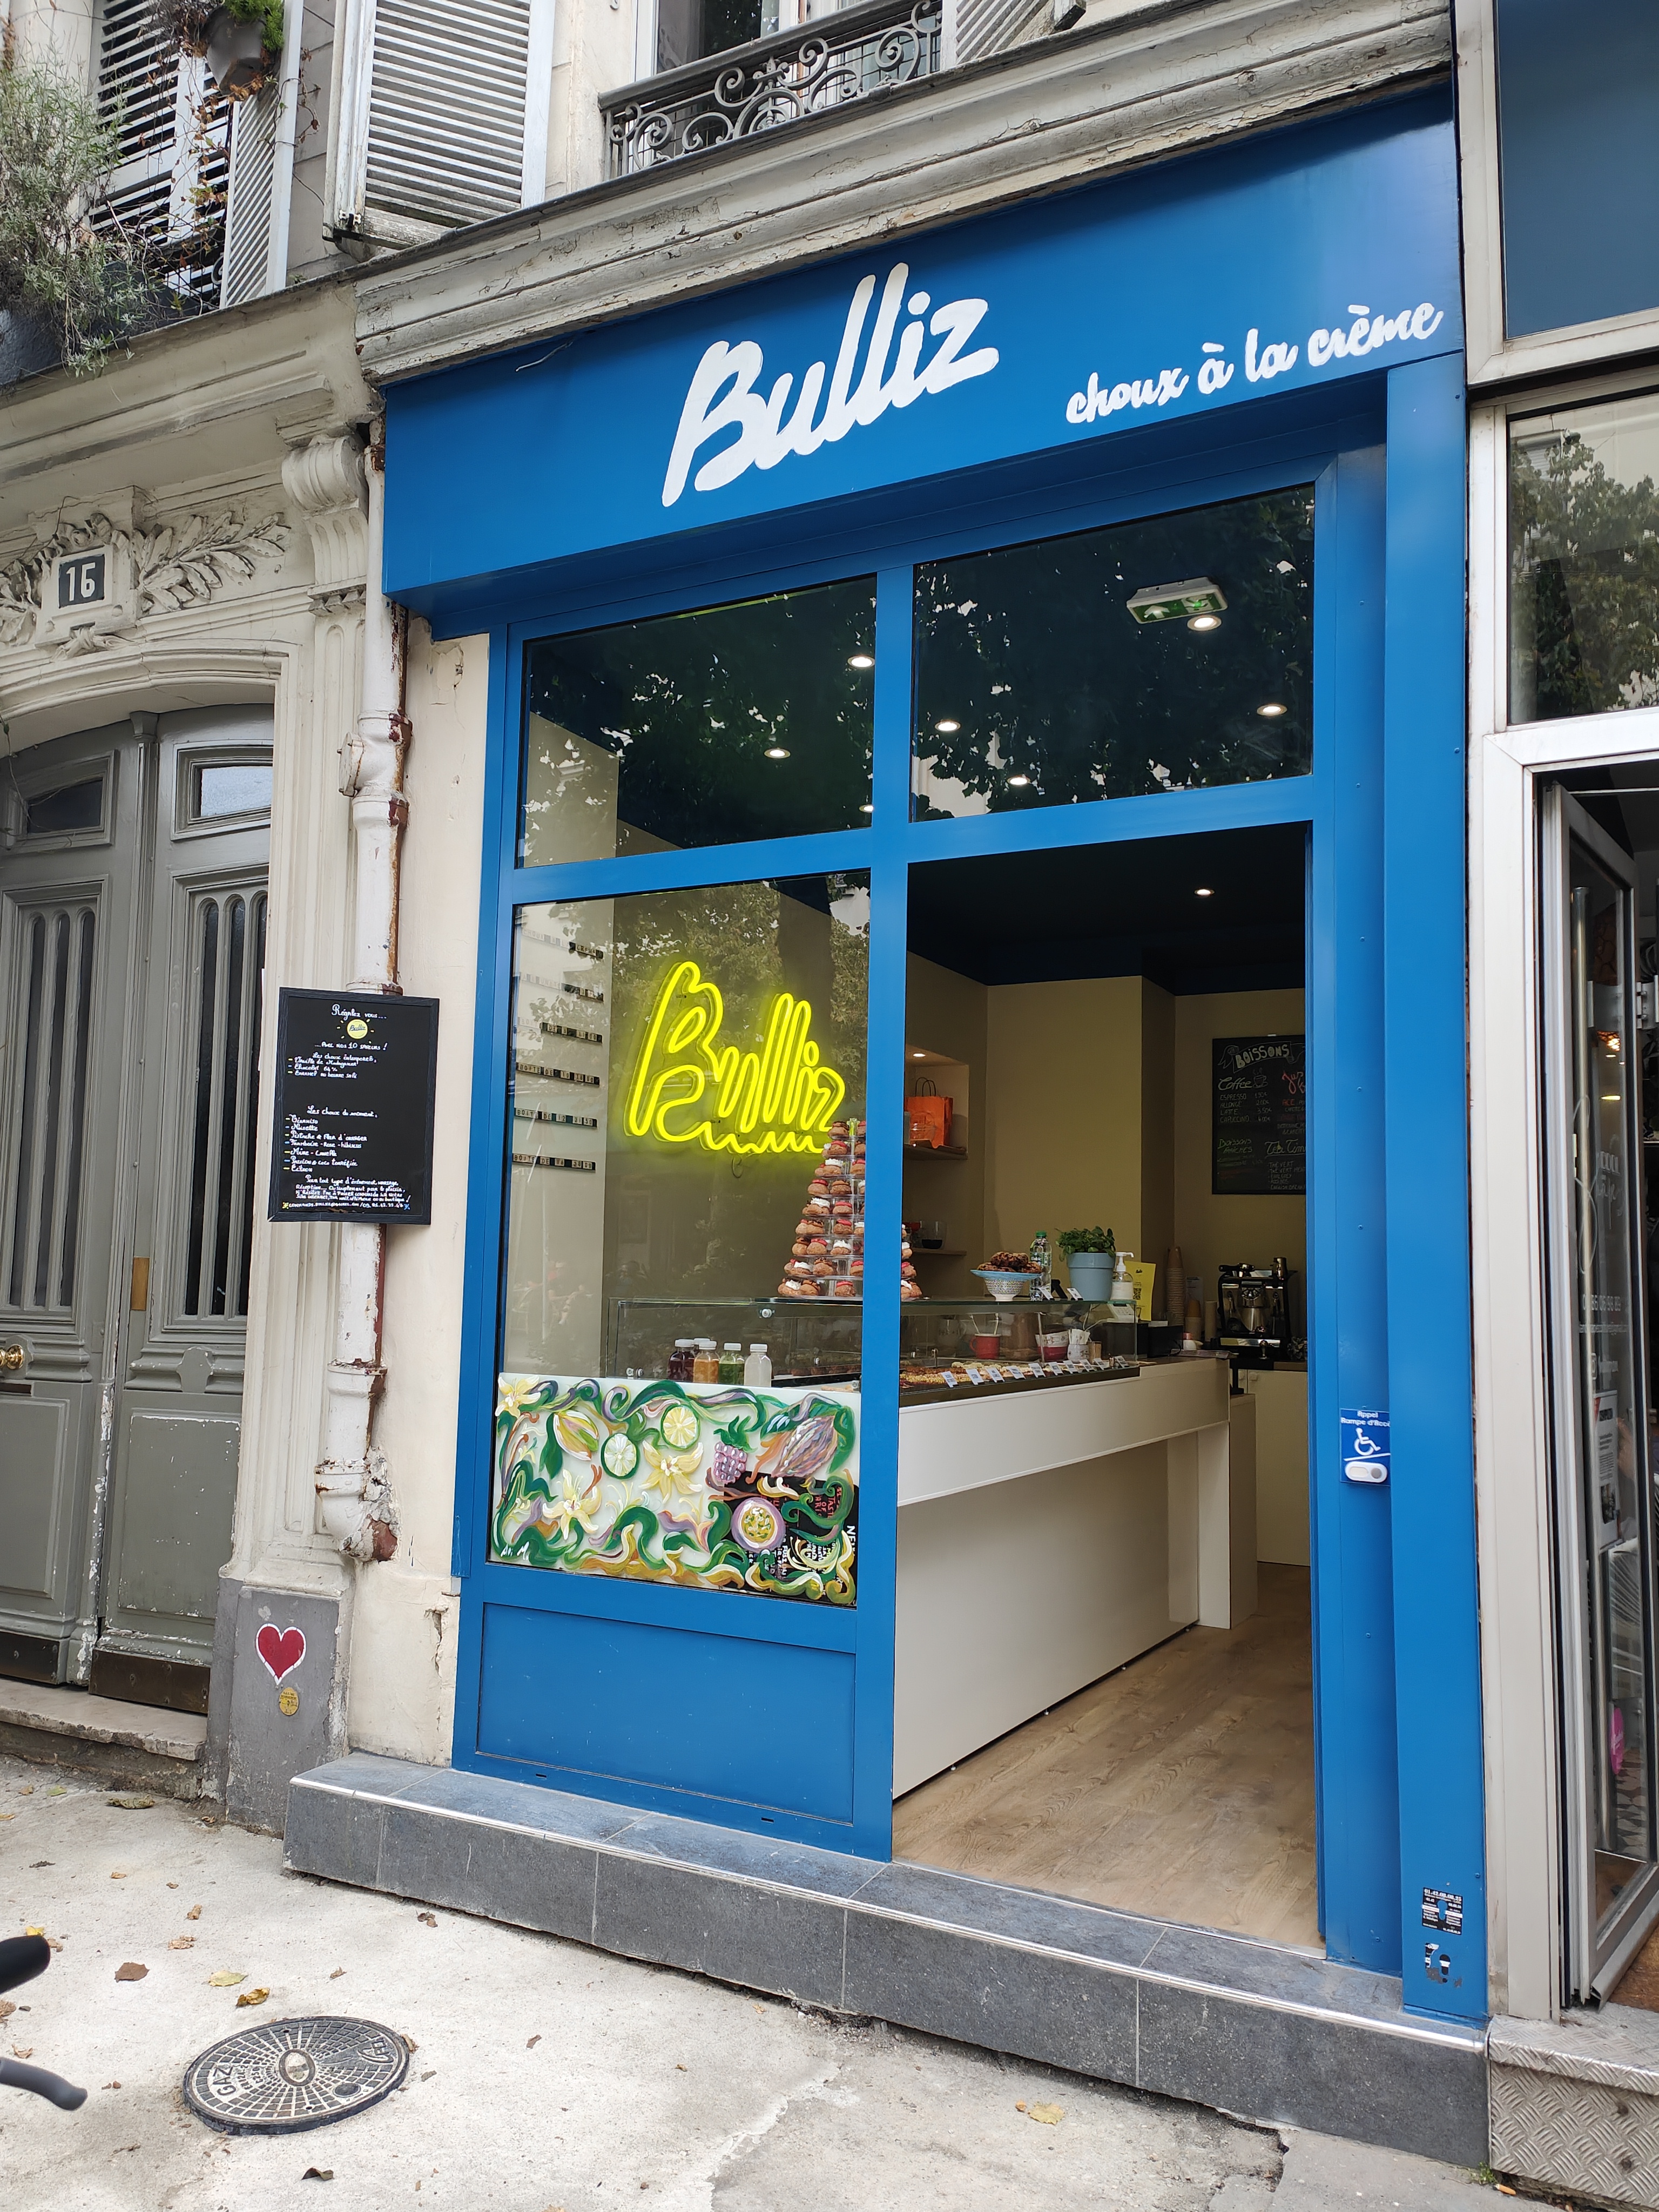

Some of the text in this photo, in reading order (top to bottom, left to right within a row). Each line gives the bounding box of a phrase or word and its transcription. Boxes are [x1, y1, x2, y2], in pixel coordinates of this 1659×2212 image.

[1066, 303, 1444, 423] choux à la crème
[662, 263, 1000, 507] Bulliz
[66, 562, 96, 602] 16
[624, 961, 845, 1154] Bulliz
[1218, 1077, 1252, 1090] Coffee
[1340, 1417, 1366, 1426] Rampe
[1357, 1411, 1379, 1419] Appel
[213, 2066, 237, 2095] GAZ
